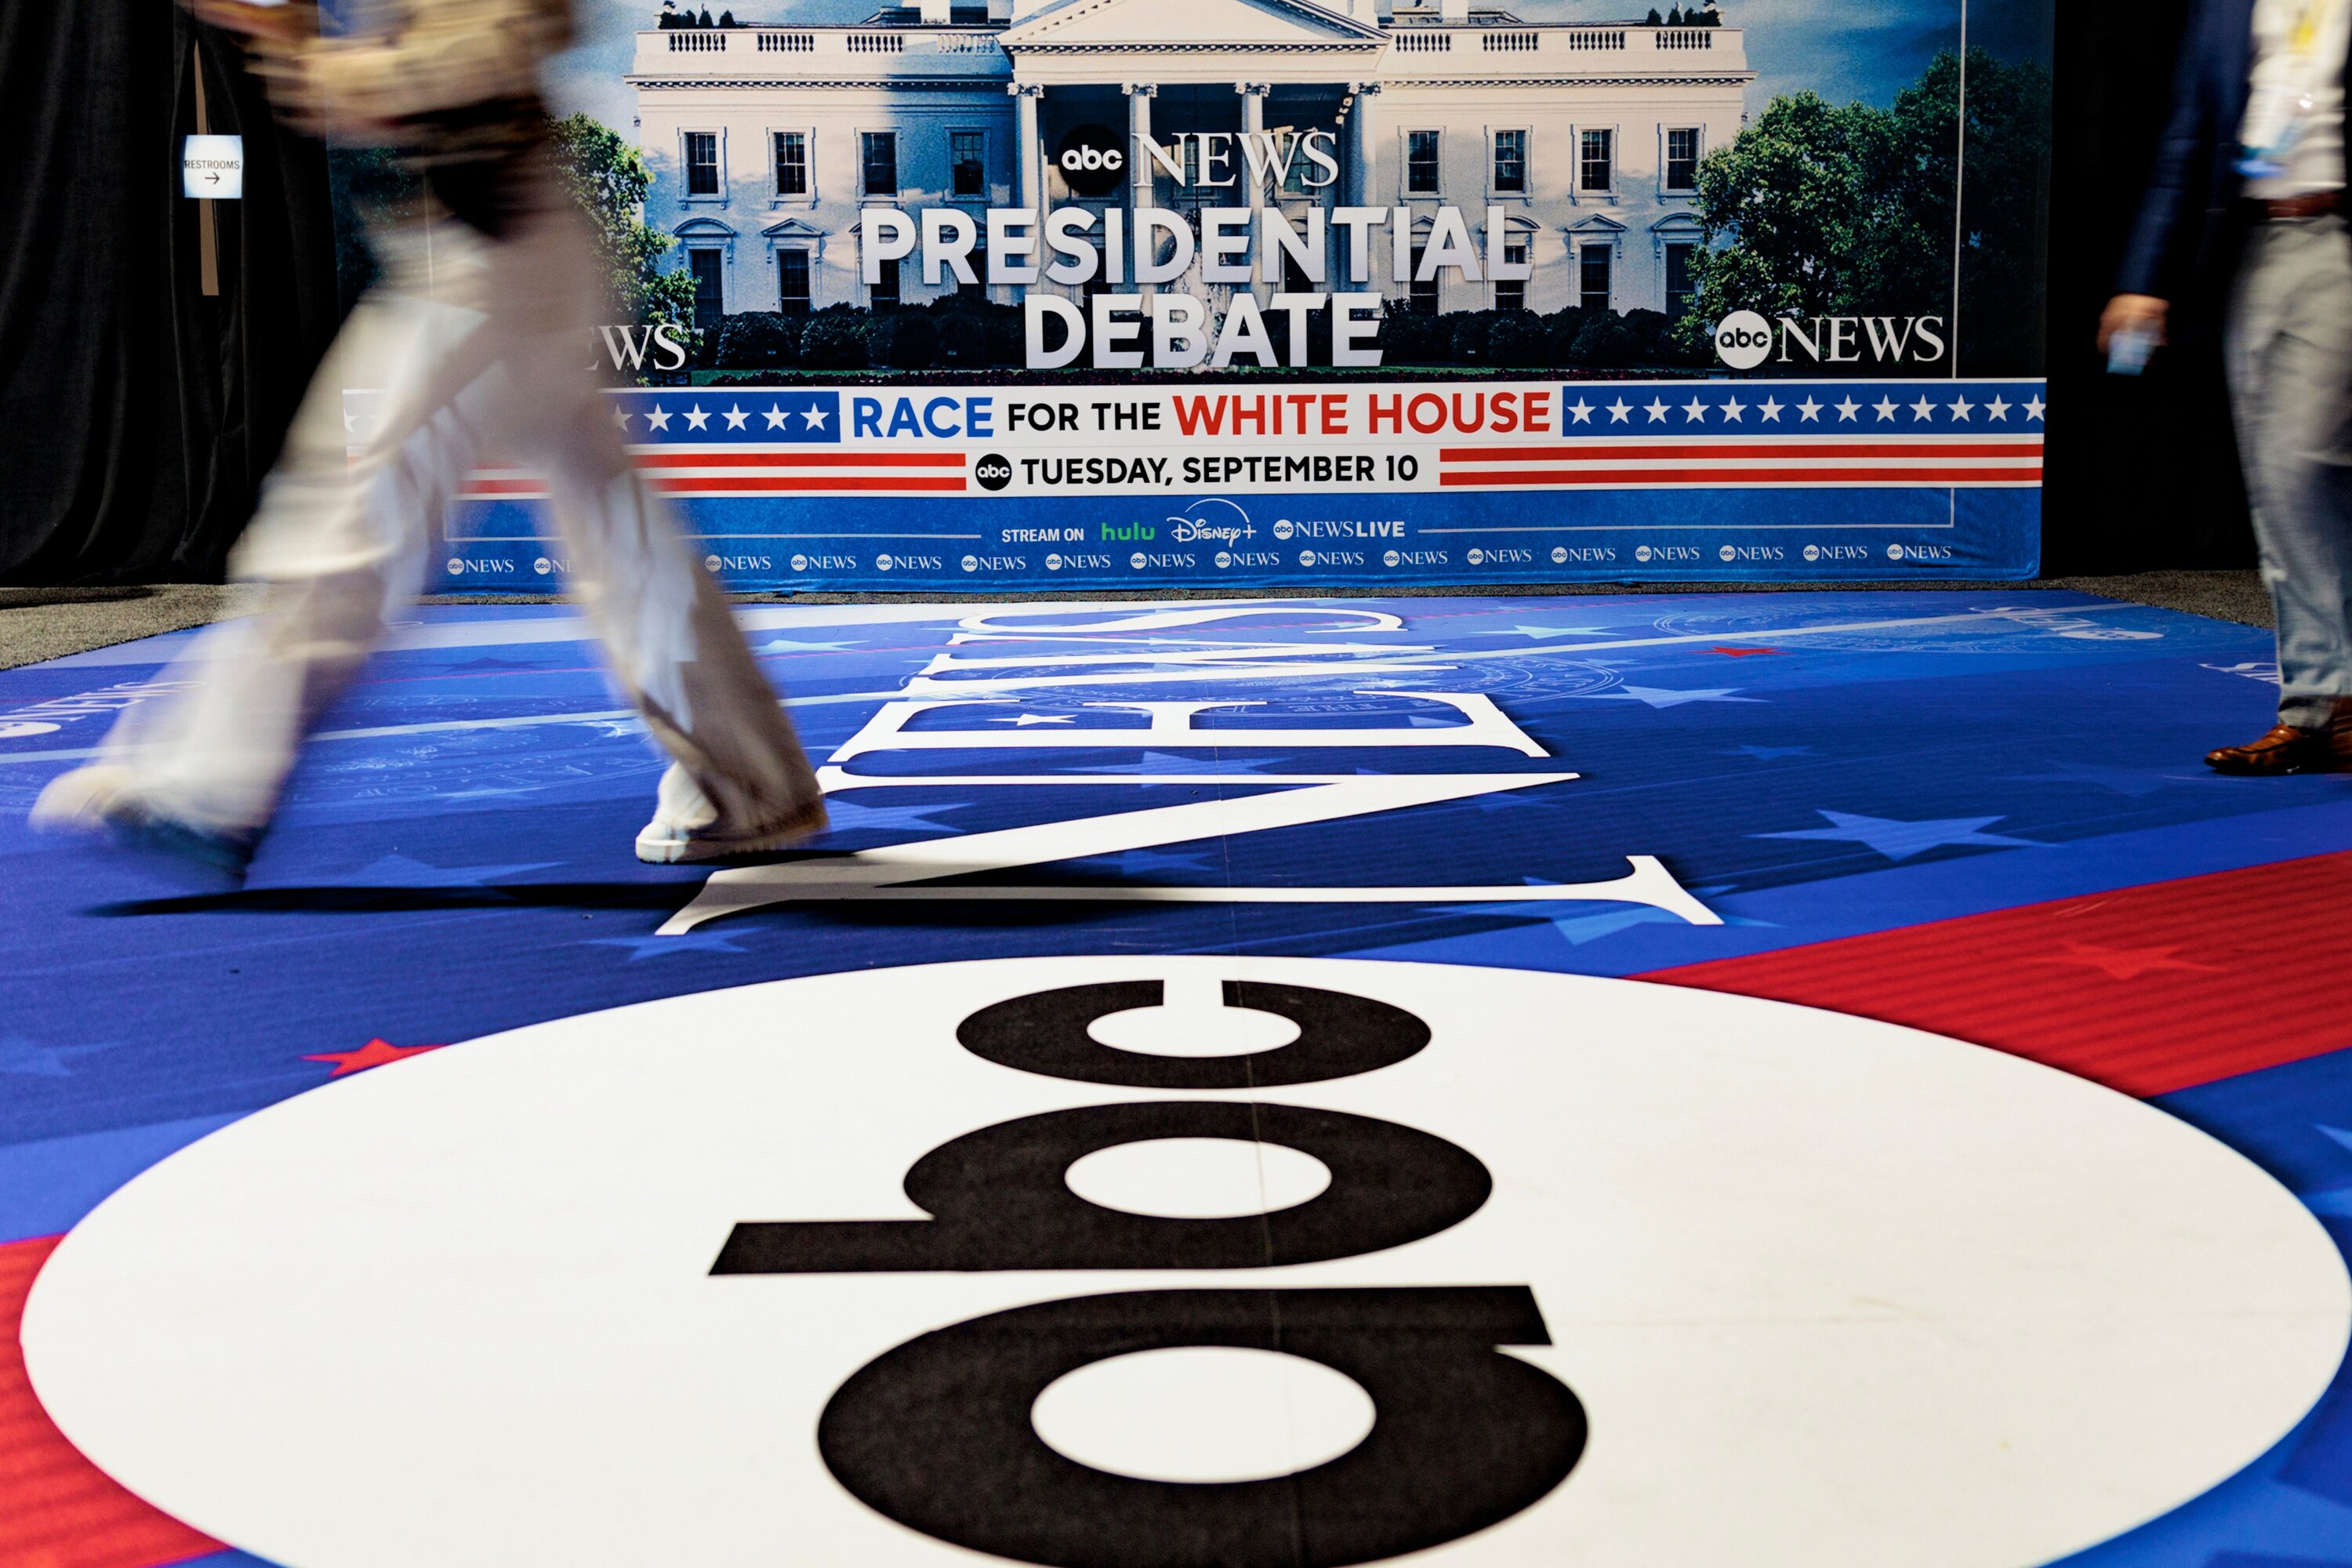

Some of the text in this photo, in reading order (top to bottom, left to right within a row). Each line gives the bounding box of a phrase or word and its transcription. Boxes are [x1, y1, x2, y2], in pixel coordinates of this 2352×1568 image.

[184, 160, 240, 169] RESTROOMS
[1062, 132, 1339, 188] abc NEWS
[862, 205, 1534, 286] PRESIDENTIAL
[1024, 292, 1384, 370] DEBATE
[1719, 315, 1945, 362] abc NEWS
[853, 391, 1551, 438] RACE FOR THE WHITE HOUSE
[977, 455, 1418, 486] abc TUESDAY, SEPTEMBER 10
[1002, 528, 1060, 543] STREAM
[1064, 528, 1084, 542] ON
[1102, 522, 1155, 540] hulu
[1318, 552, 1363, 564] NEWS
[1402, 551, 1447, 564] NEWS
[1485, 550, 1531, 562] NEWS
[1570, 548, 1615, 561] NEWS
[1653, 547, 1699, 559] NEWS
[1737, 546, 1783, 559] NEWS
[1821, 546, 1867, 558] NEWS
[1905, 546, 1951, 558] NEWS
[466, 559, 514, 572] NEWS
[724, 556, 771, 569] NEWS
[809, 556, 856, 568] NEWS
[895, 556, 941, 568] NEWS
[979, 557, 1025, 570] NEWS
[1064, 554, 1110, 568] NEWS
[1149, 554, 1195, 567] NEWS
[1232, 553, 1279, 565] NEWS
[655, 606, 1723, 936] NEWS
[708, 978, 1588, 1568] abc
